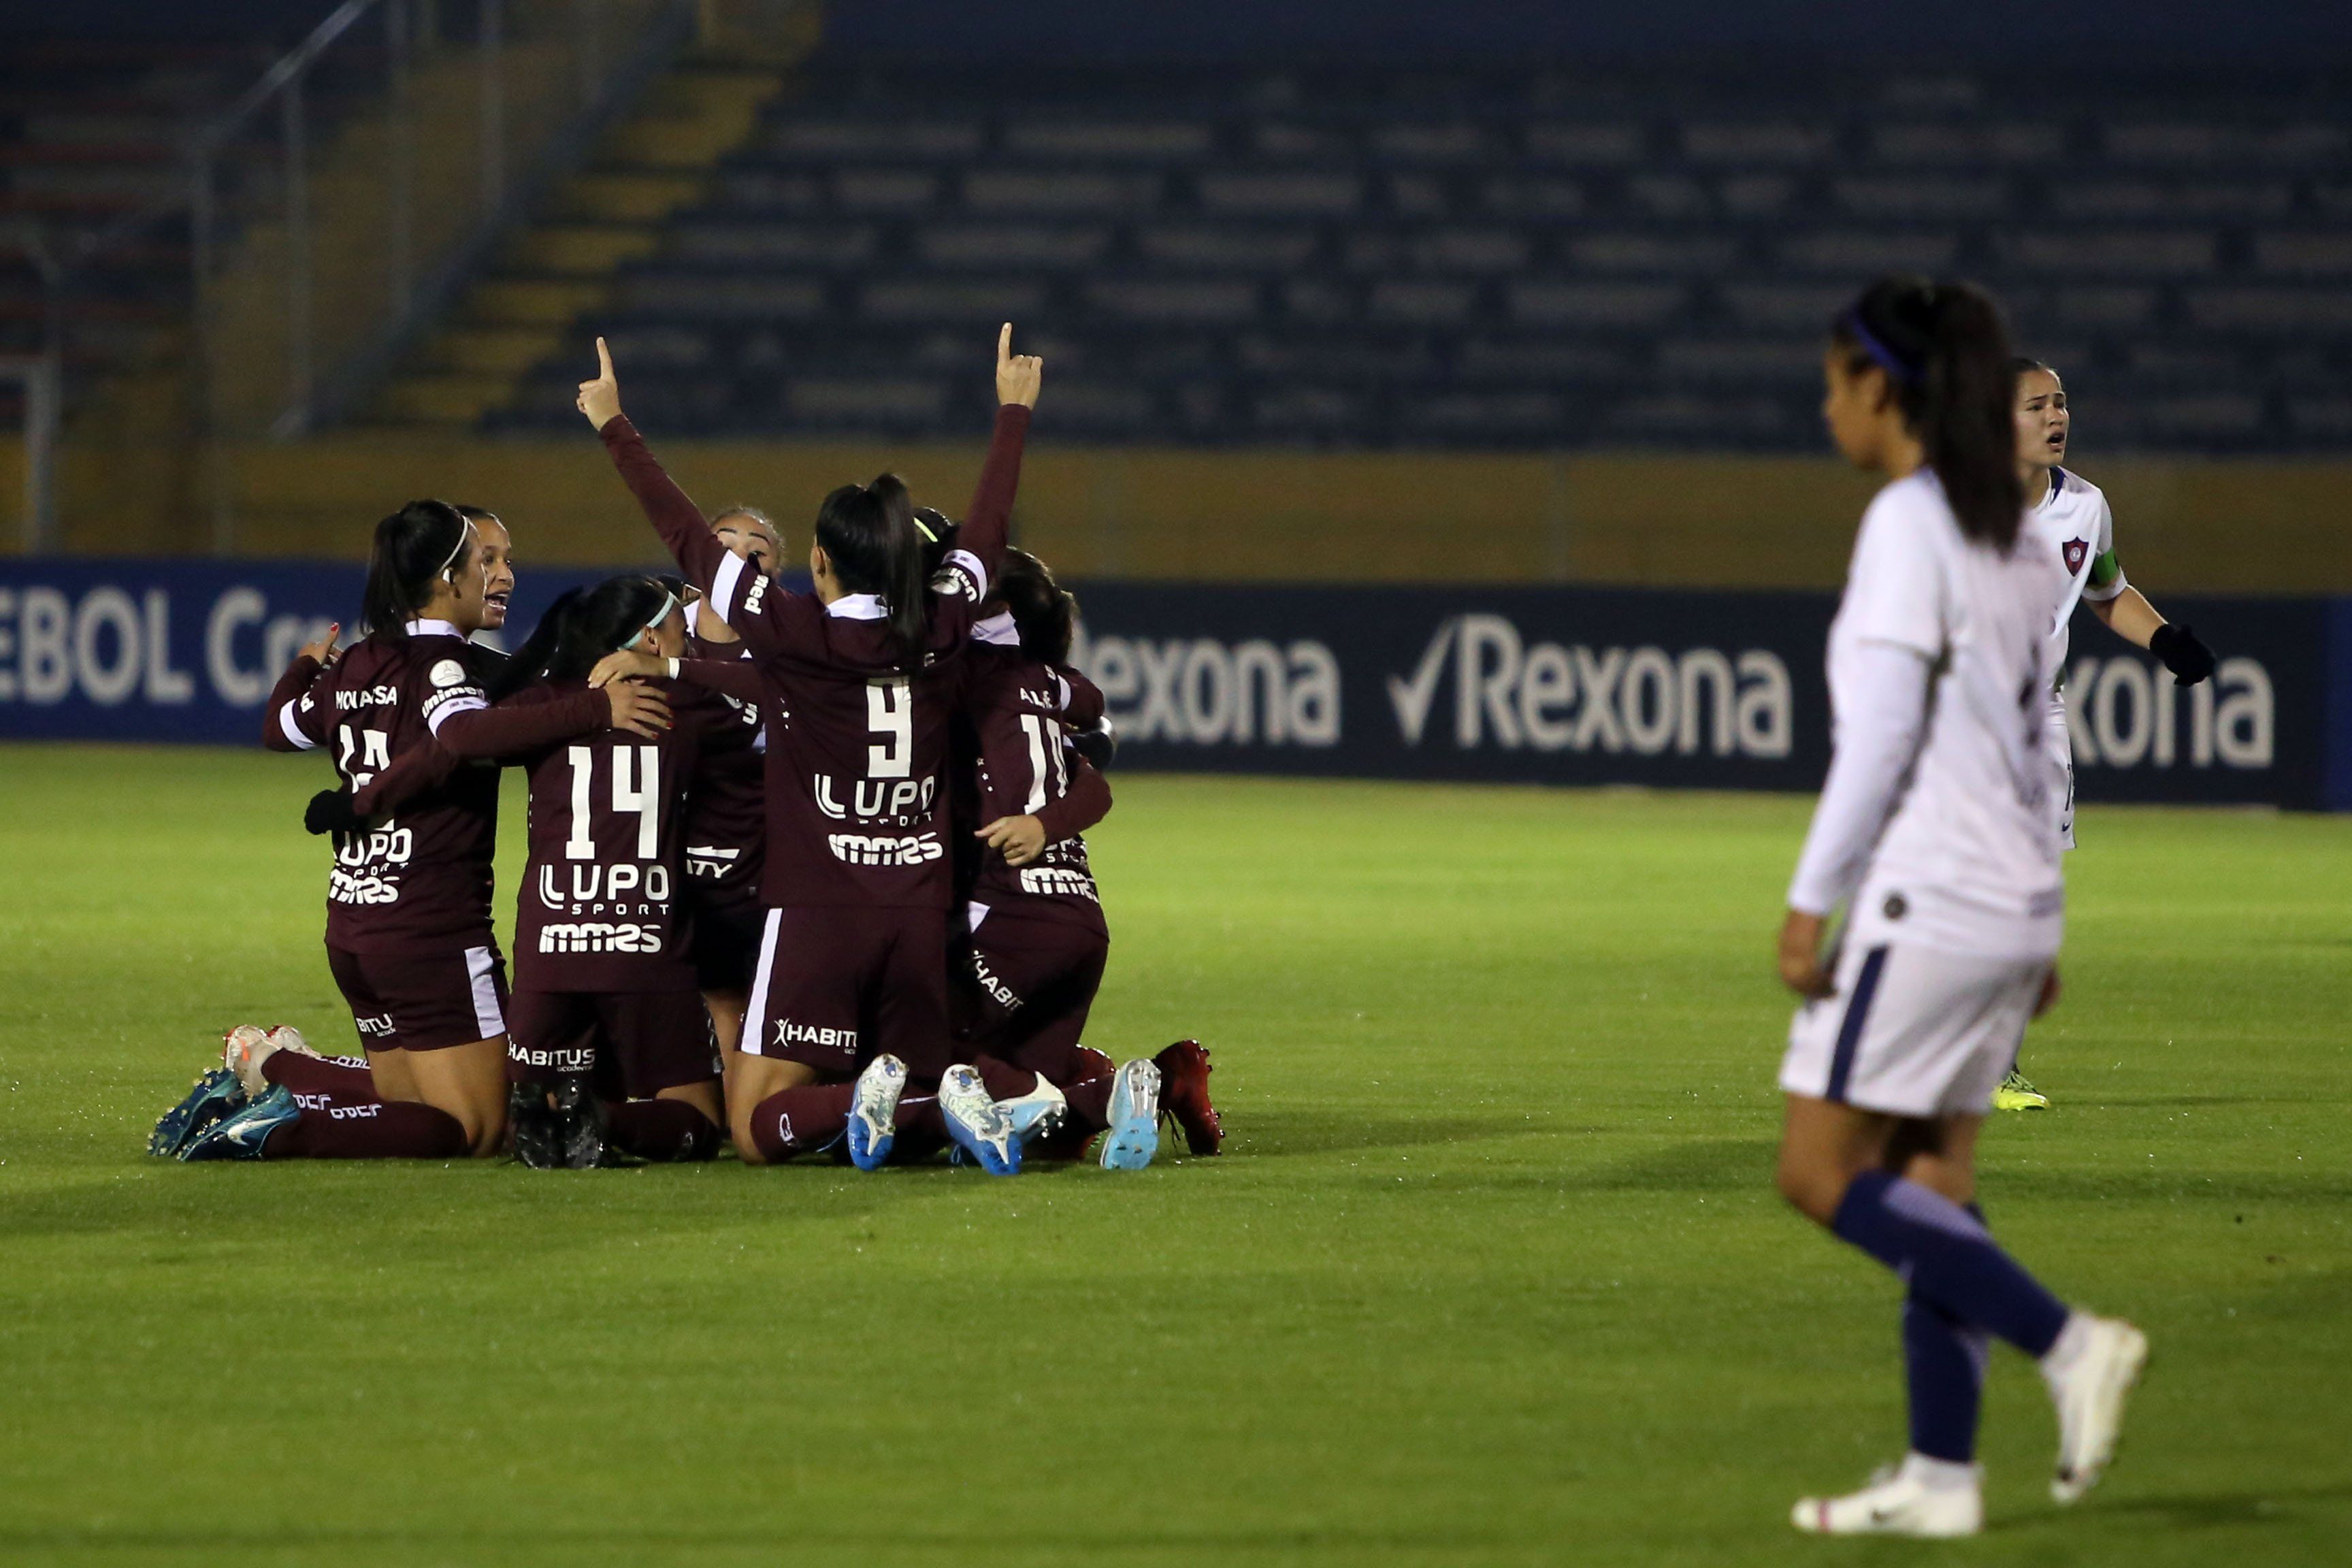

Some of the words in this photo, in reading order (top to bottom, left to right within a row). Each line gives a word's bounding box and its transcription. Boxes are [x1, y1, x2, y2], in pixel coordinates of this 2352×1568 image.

[1070, 621, 1342, 747] exona
[1456, 614, 1792, 758] Rexona
[866, 677, 912, 777] 9
[2062, 655, 2276, 769] xona
[566, 746, 659, 860] 14
[815, 774, 934, 819] LUPO
[333, 828, 413, 866] UPO
[540, 864, 669, 910] LUPO
[572, 903, 669, 915] SPORT
[977, 960, 1024, 1012] HABIT
[356, 1013, 394, 1033] BITU
[786, 1024, 857, 1047] HABIT
[507, 1040, 595, 1066] HABITUS
[293, 1094, 331, 1111] LUP
